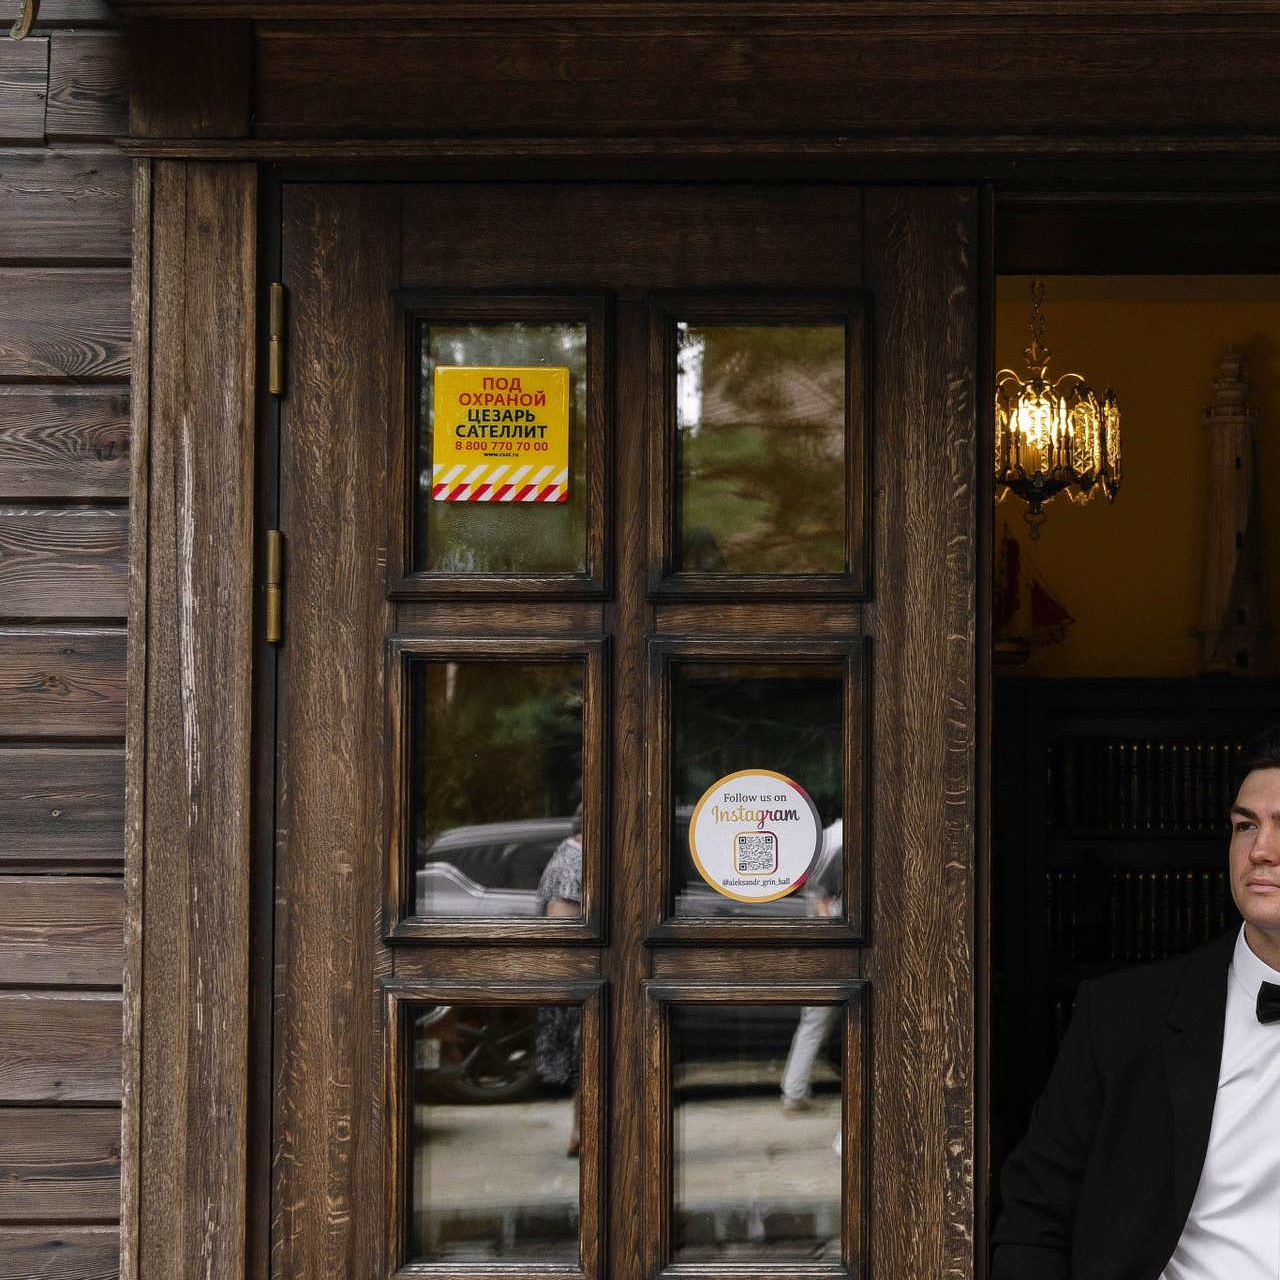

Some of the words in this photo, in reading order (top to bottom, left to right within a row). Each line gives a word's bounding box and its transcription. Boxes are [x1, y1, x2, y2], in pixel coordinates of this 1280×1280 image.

[482, 377, 522, 393] ПОД
[458, 390, 546, 407] ОХРАНОЙ
[468, 409, 536, 424] ЦЕЗАРЬ
[455, 424, 548, 439] САТЕЛЛИТ
[455, 441, 463, 451] 8
[465, 441, 488, 451] 800
[491, 441, 513, 451] 770
[516, 441, 531, 452] 70
[533, 441, 549, 452] 00
[723, 793, 758, 803] Follow
[760, 794, 772, 802] us
[774, 794, 787, 802] on
[711, 804, 800, 830] Instagram
[722, 877, 791, 887] @aleksandr_grin_hall
